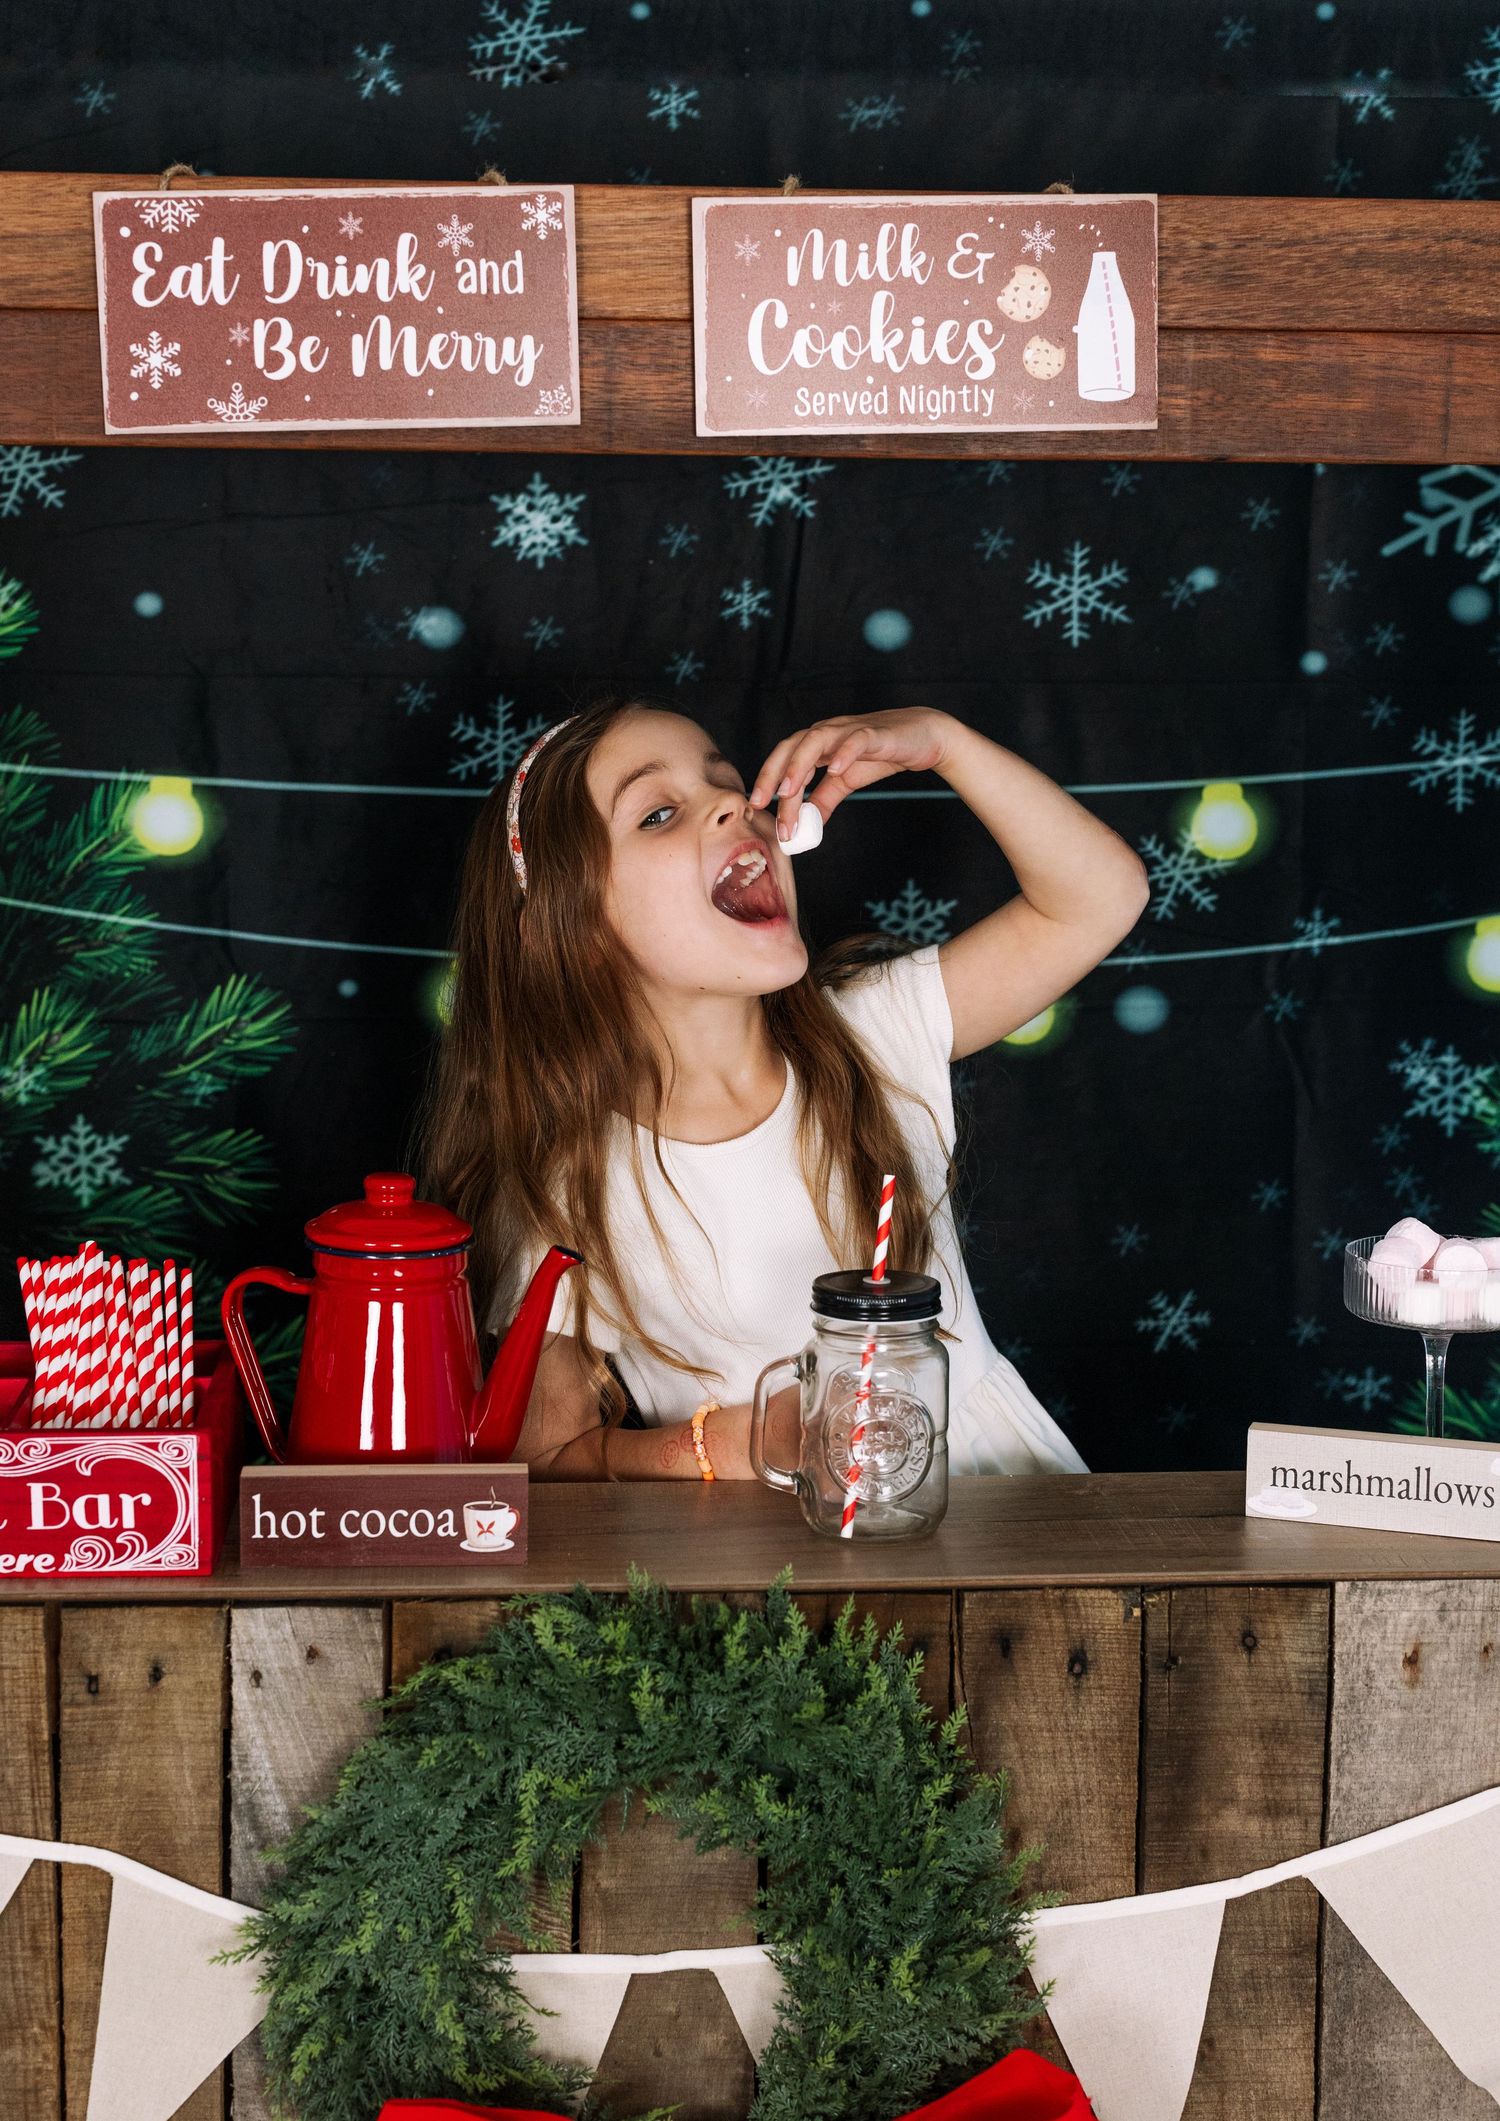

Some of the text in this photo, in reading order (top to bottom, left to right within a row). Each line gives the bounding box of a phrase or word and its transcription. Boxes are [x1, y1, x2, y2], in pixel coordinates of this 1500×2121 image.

[131, 231, 525, 308] Eat Drink and
[786, 222, 996, 287] Milk &
[253, 314, 544, 387] Be Merry
[747, 290, 1006, 381] Cookies
[794, 384, 995, 421] Served Nightly
[26, 1482, 152, 1531] Bar
[1269, 1459, 1495, 1509] marshmallows
[251, 1493, 459, 1539] hot cocoa
[0, 1553, 56, 1574] ere
